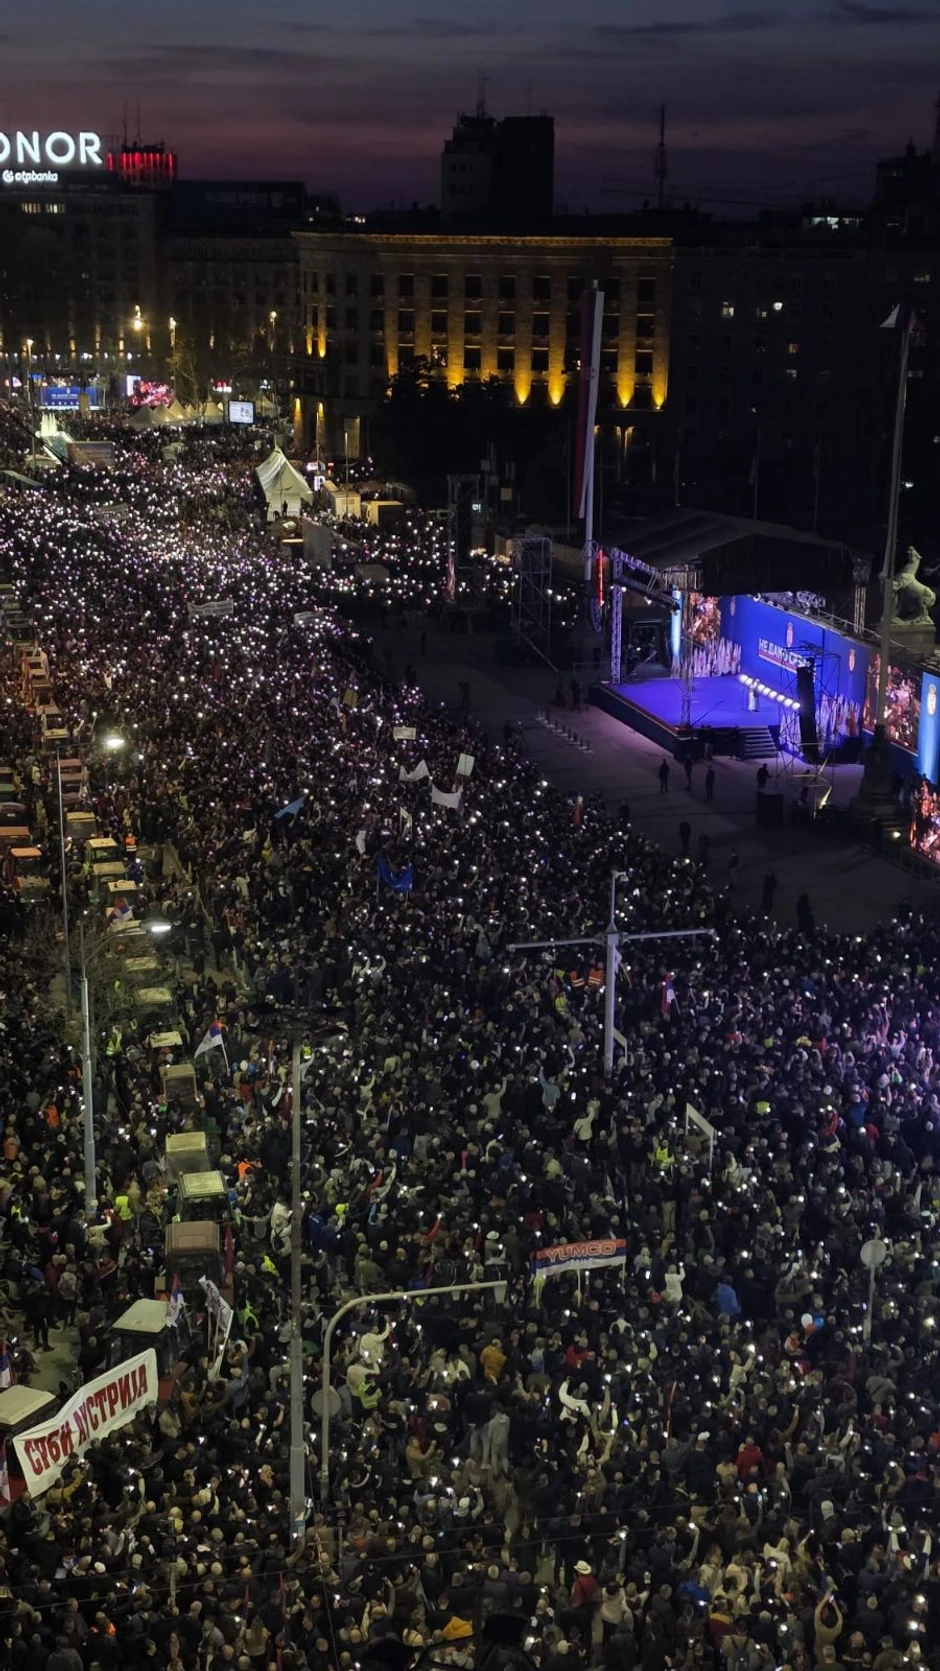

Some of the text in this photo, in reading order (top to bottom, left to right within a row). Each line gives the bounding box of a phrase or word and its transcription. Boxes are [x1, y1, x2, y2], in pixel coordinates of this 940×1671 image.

[759, 638, 768, 653] НЕ
[546, 1241, 617, 1262] YUMCO
[24, 1363, 149, 1476] СРБИ АУСТРИЈА
